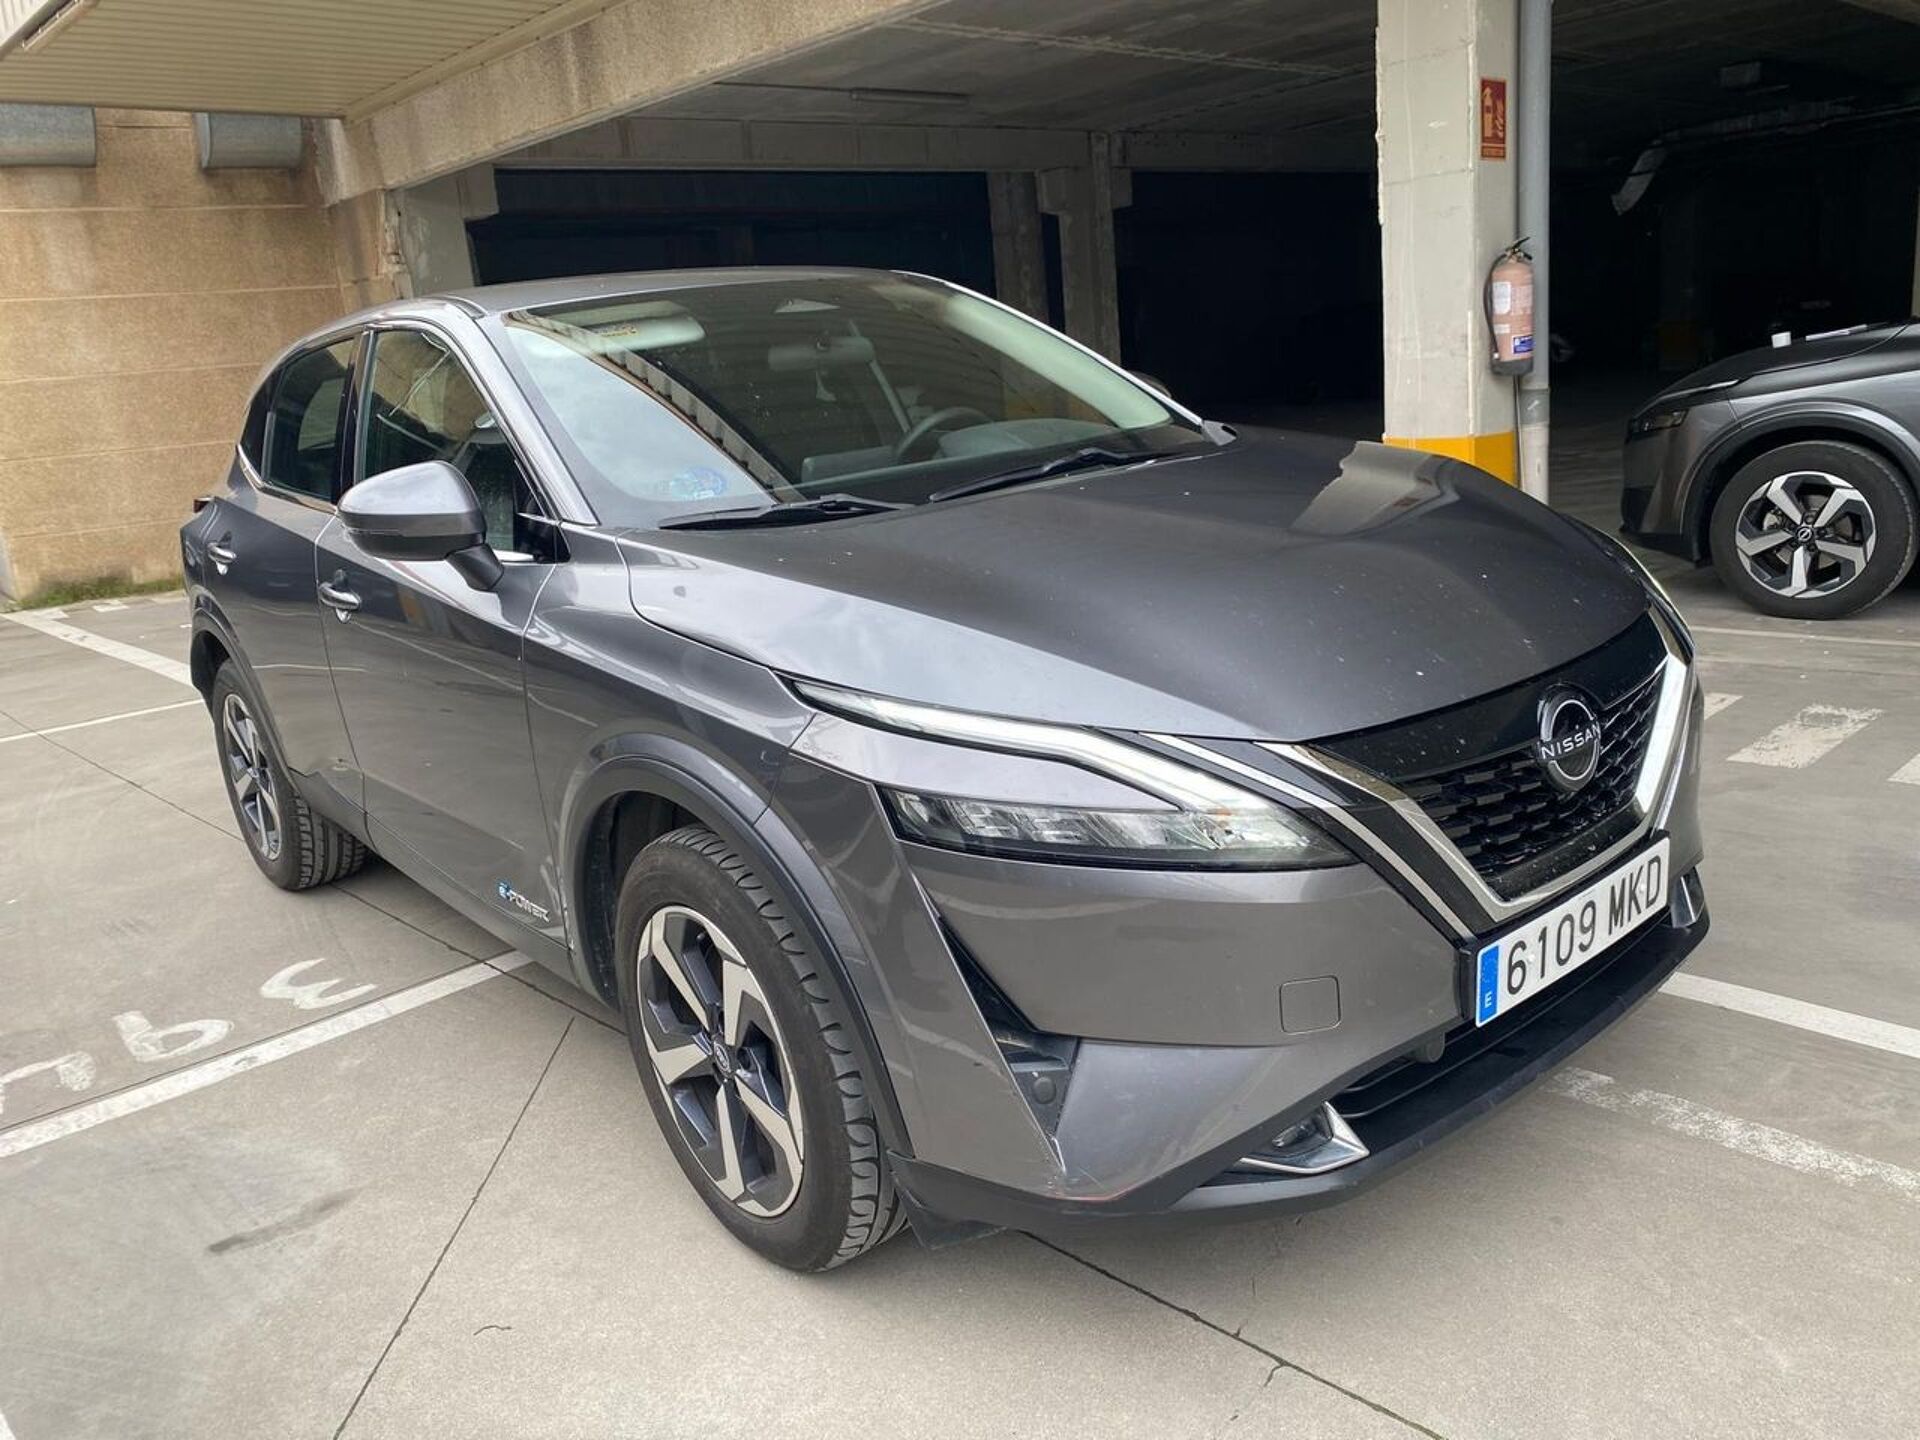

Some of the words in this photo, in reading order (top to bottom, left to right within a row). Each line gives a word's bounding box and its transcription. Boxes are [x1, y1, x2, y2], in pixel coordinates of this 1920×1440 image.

[1541, 724, 1601, 759] NISSAN
[1506, 900, 1597, 995] 6109
[1608, 855, 1662, 936] MKD
[1485, 991, 1492, 1008] E
